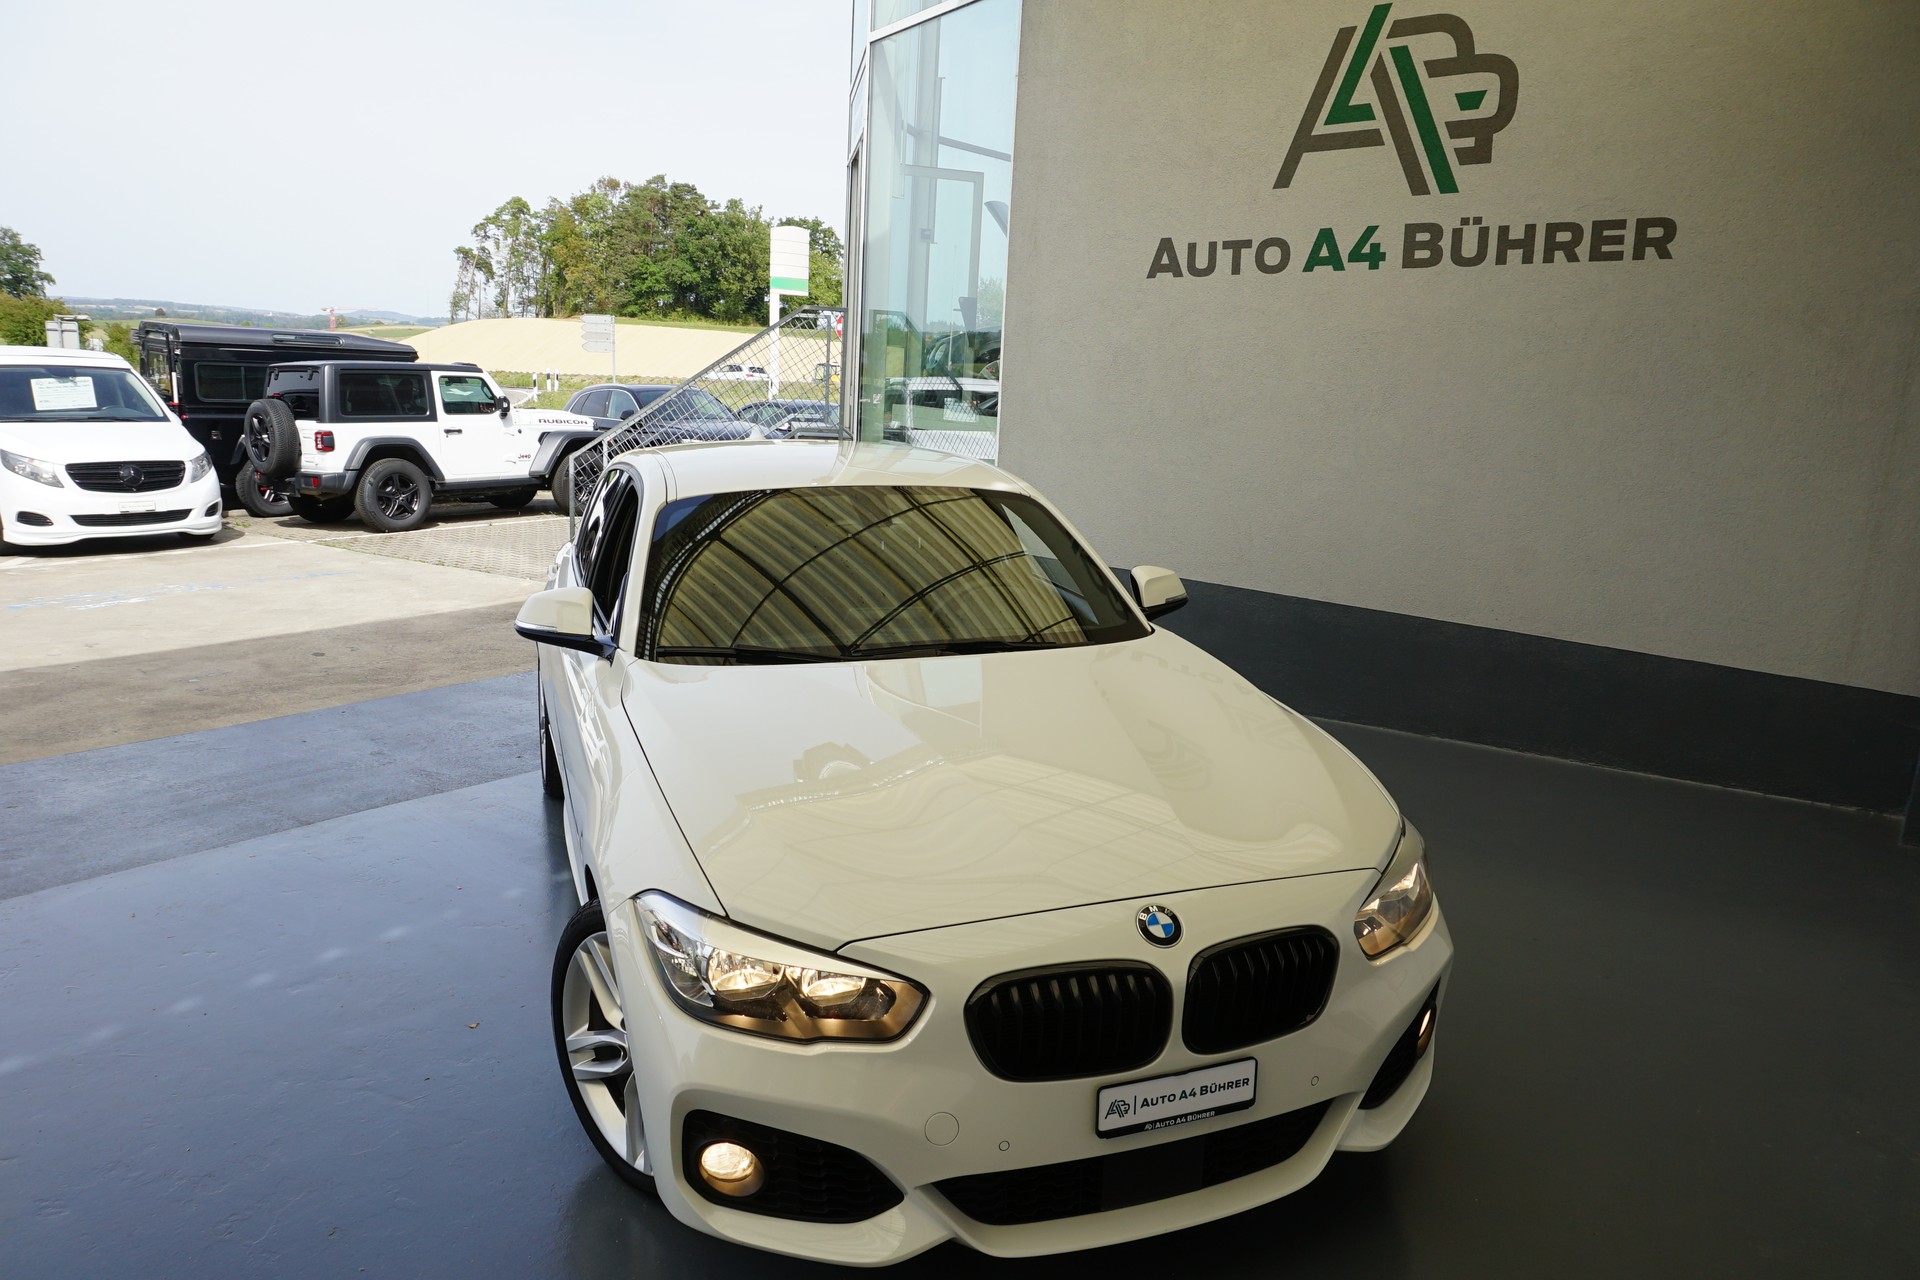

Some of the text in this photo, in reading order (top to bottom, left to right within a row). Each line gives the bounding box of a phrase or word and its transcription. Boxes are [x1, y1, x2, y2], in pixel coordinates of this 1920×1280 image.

[1146, 216, 1678, 279] AUTO A4 BÜHRER
[1139, 905, 1173, 921] BMW
[1140, 1093, 1176, 1109] AUTO
[1179, 1088, 1197, 1101] A4
[1200, 1077, 1250, 1096] BÜHRER
[1155, 1119, 1175, 1129] AUTO
[1176, 1116, 1186, 1124] A4
[1187, 1111, 1216, 1122] BÜHRER
